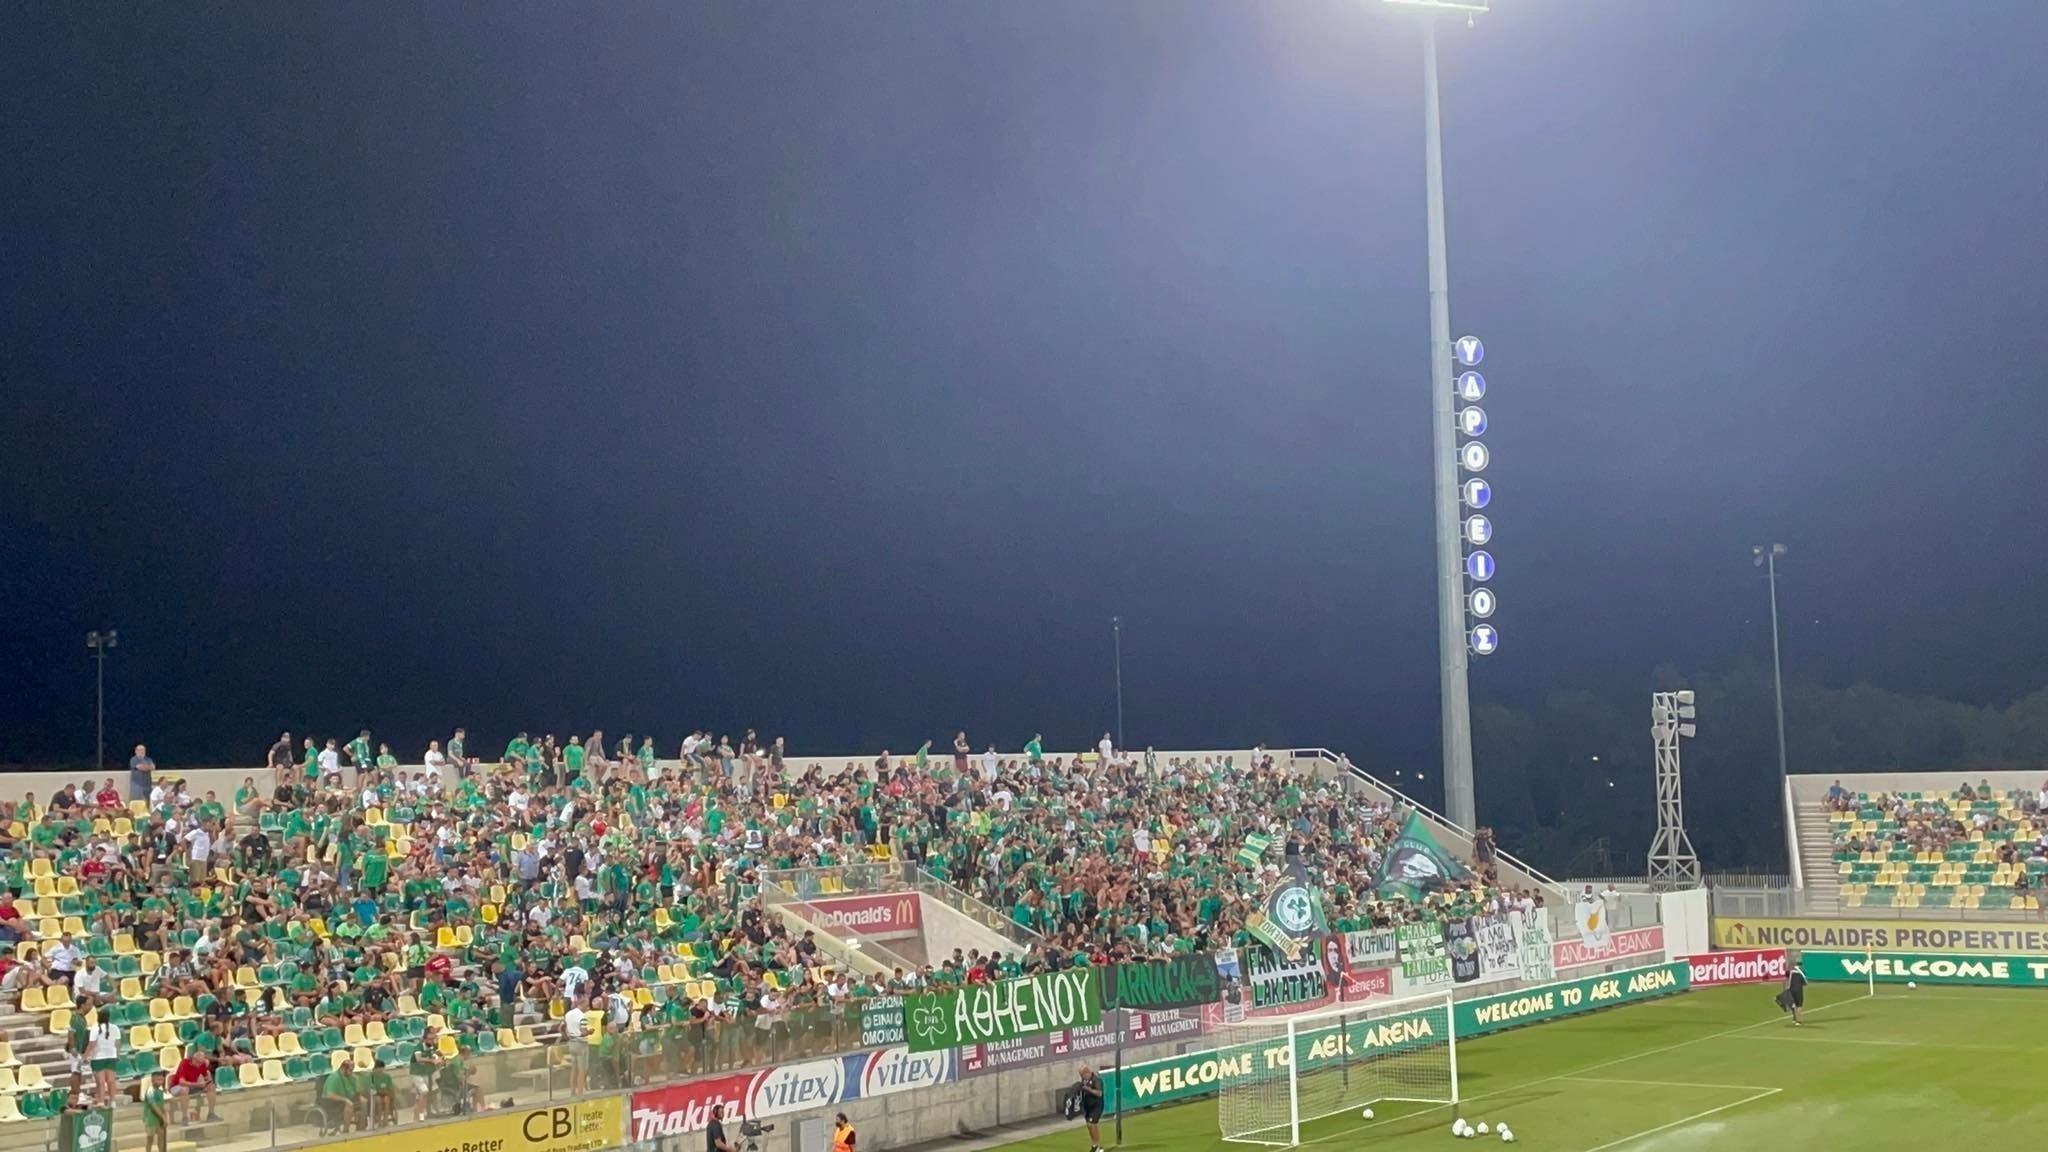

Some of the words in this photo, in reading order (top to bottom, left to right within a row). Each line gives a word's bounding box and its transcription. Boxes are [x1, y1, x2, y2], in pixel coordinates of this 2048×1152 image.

[1461, 340, 1492, 650] ΥΔΡΟΓΕΙΟΣ
[812, 906, 891, 928] McDonald's
[1618, 931, 1652, 953] BANK
[1757, 926, 1888, 946] NICOLAIDES
[1841, 958, 2009, 979] WELCOME
[1100, 960, 1196, 1009] LARNACA
[1475, 992, 1553, 1025] WELCOME
[1561, 988, 1582, 1007] TO
[1590, 979, 1621, 1001] AEK
[1627, 970, 1676, 993] ARENA
[1148, 1009, 1179, 1024] WEALTH
[1150, 1018, 1199, 1038] MANAGEMENT
[877, 1051, 935, 1088] vitex
[987, 1045, 1045, 1067] MANAGEMENT
[1132, 1053, 1253, 1098] WELCOME
[1263, 1045, 1290, 1069] TO
[1363, 1018, 1433, 1048] ARENA
[764, 1072, 828, 1108] vitex
[523, 1107, 572, 1143] CB
